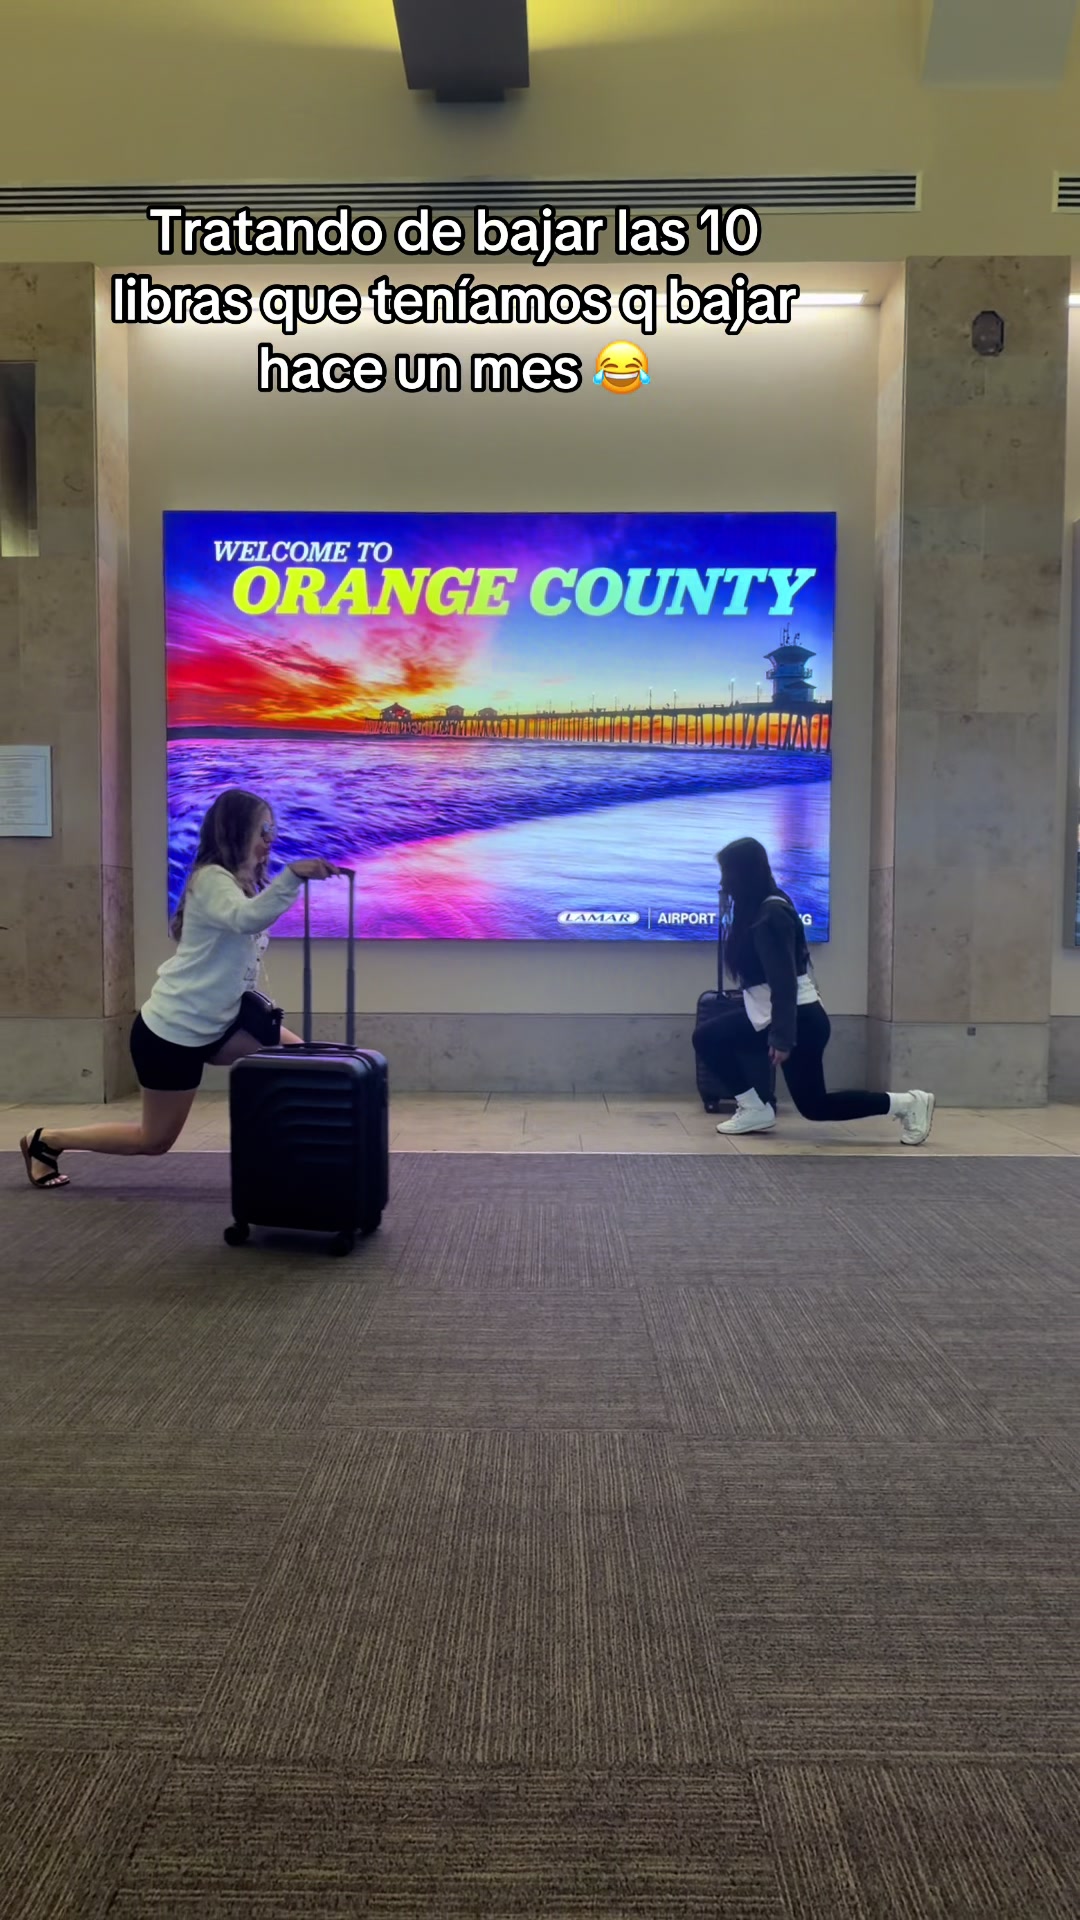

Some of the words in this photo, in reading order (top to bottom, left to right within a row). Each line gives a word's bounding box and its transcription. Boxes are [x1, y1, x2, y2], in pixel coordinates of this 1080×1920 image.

[213, 540, 350, 563] WELCOME
[357, 540, 393, 563] TO
[232, 566, 517, 616] ORANGE
[529, 567, 816, 616] COUNTY
[565, 912, 631, 923] LAMAR
[657, 912, 717, 925] AIRPORT
